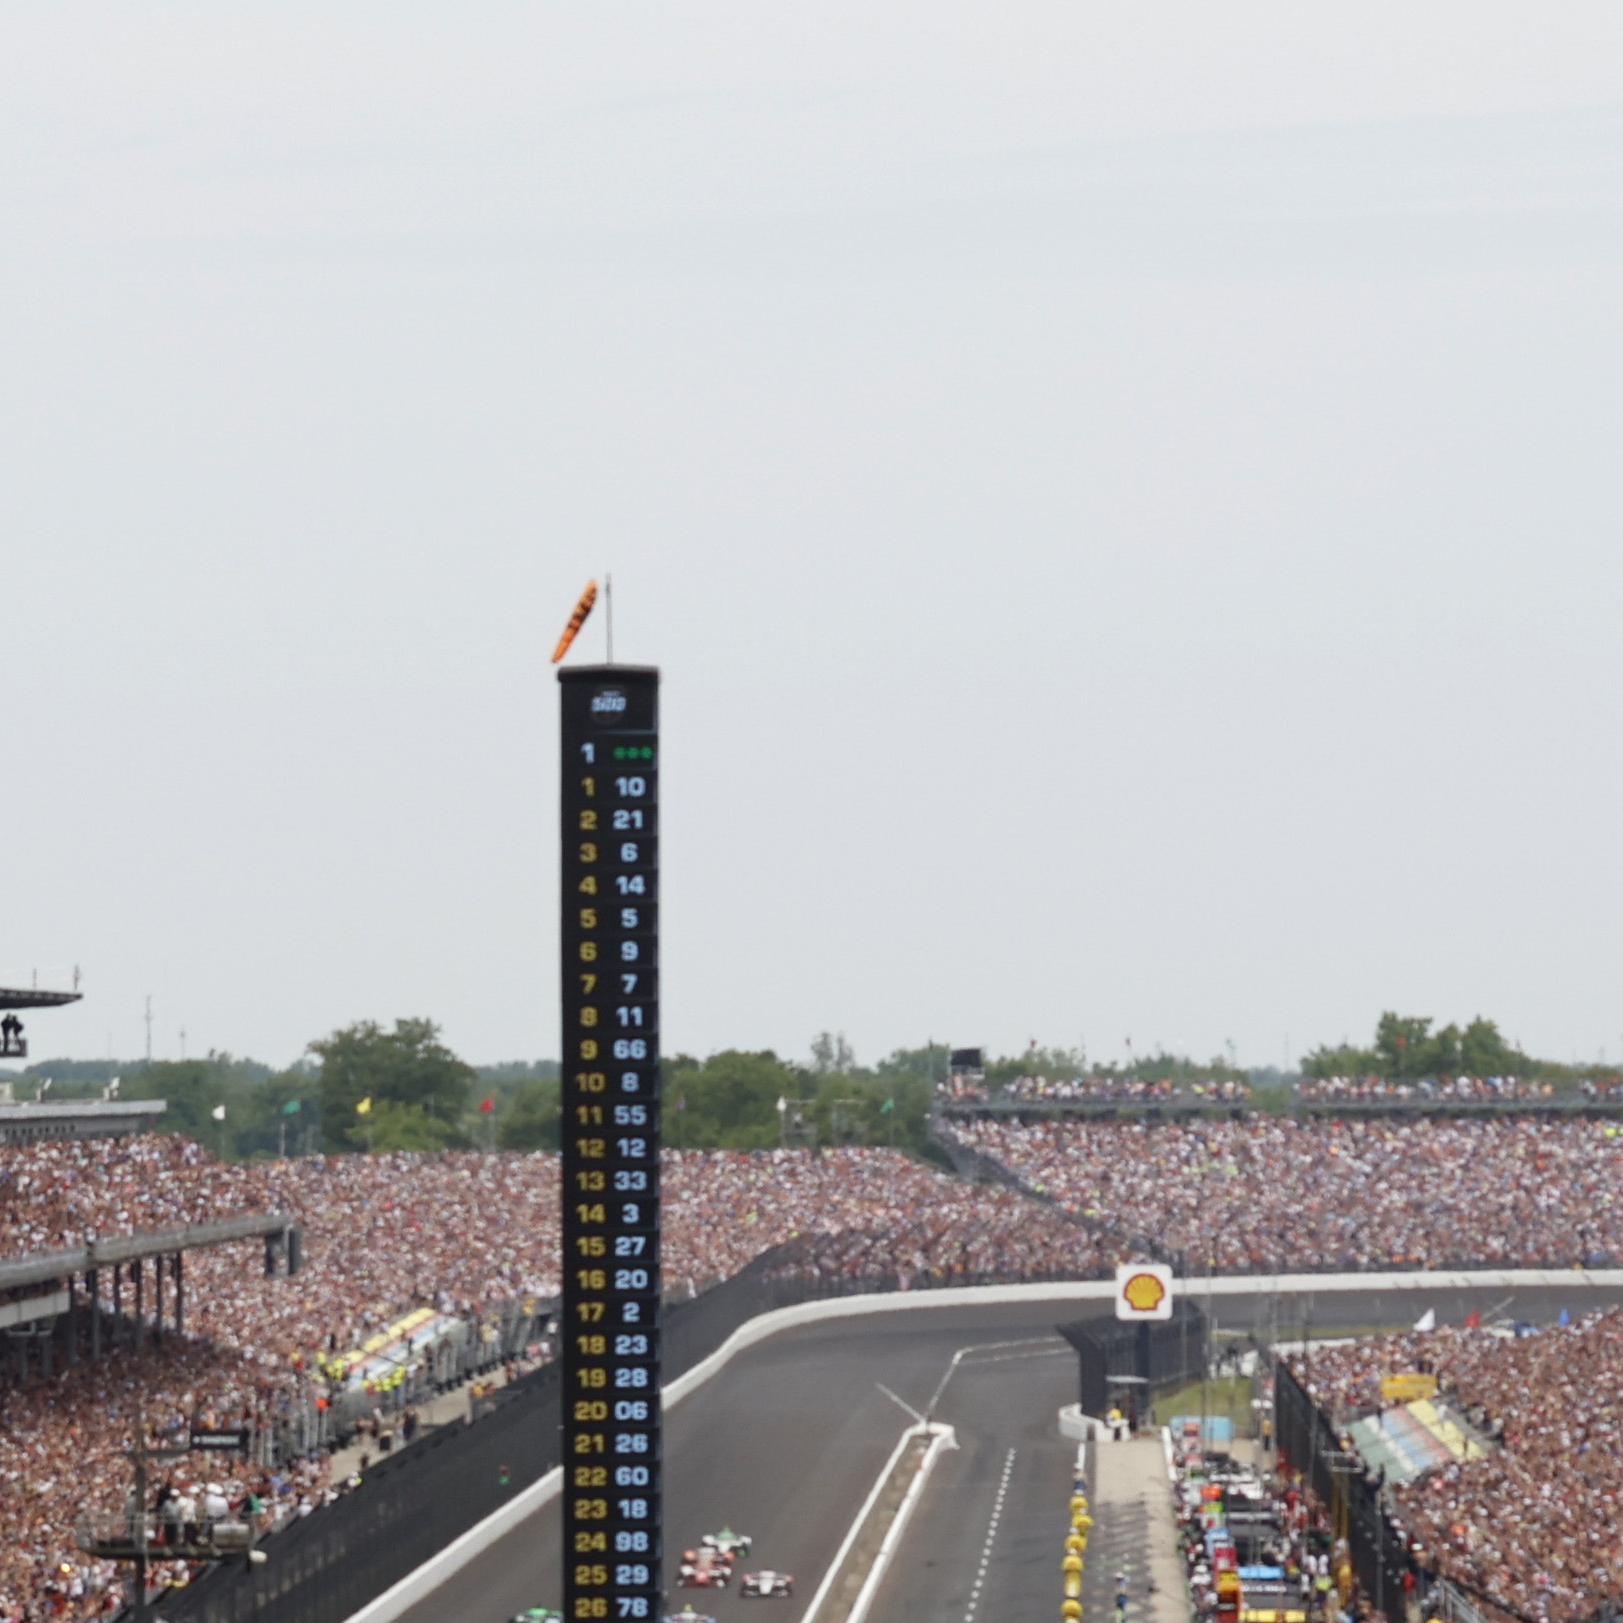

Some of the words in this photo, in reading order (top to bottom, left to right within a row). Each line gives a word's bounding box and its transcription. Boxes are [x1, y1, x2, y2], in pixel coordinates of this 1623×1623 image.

[580, 742, 595, 764] 1
[581, 776, 595, 796] 1
[614, 776, 647, 798] 10
[579, 809, 598, 830] 2
[612, 809, 644, 830] 21
[579, 842, 598, 863] 3
[620, 842, 639, 863] 6
[578, 875, 598, 895] 4
[615, 874, 647, 895] 14
[580, 907, 597, 929] 5
[620, 907, 639, 929] 5
[579, 941, 597, 962] 6
[620, 940, 639, 962] 9
[580, 973, 597, 994] 7
[620, 973, 638, 995] 7
[580, 1006, 598, 1027] 8
[615, 1005, 643, 1027] 11
[580, 1039, 598, 1060] 9
[612, 1038, 648, 1061] 66
[576, 1072, 606, 1093] 10
[621, 1071, 640, 1093] 8
[577, 1105, 602, 1124] 11
[613, 1104, 647, 1126] 55
[577, 1138, 605, 1158] 12
[616, 1137, 647, 1158] 12
[576, 1170, 606, 1191] 13
[614, 1170, 647, 1192] 33
[576, 1203, 606, 1223] 14
[622, 1202, 640, 1224] 3
[576, 1236, 606, 1257] 15
[614, 1235, 647, 1257] 27
[577, 1268, 606, 1290] 16
[614, 1268, 649, 1290] 20
[577, 1301, 605, 1322] 17
[622, 1301, 641, 1323] 2
[577, 1334, 606, 1355] 18
[614, 1334, 648, 1356] 23
[577, 1367, 607, 1388] 19
[614, 1367, 649, 1388] 28
[574, 1400, 608, 1421] 20
[614, 1400, 649, 1421] 06
[574, 1433, 604, 1454] 21
[614, 1432, 649, 1454] 26
[574, 1466, 607, 1487] 22
[614, 1465, 650, 1487] 60
[574, 1498, 607, 1520] 23
[617, 1498, 648, 1520] 18
[575, 1531, 607, 1553] 24
[614, 1530, 650, 1553] 98
[575, 1564, 608, 1586] 25
[615, 1563, 650, 1586] 29
[574, 1597, 608, 1618] 26
[615, 1596, 649, 1618] 78
